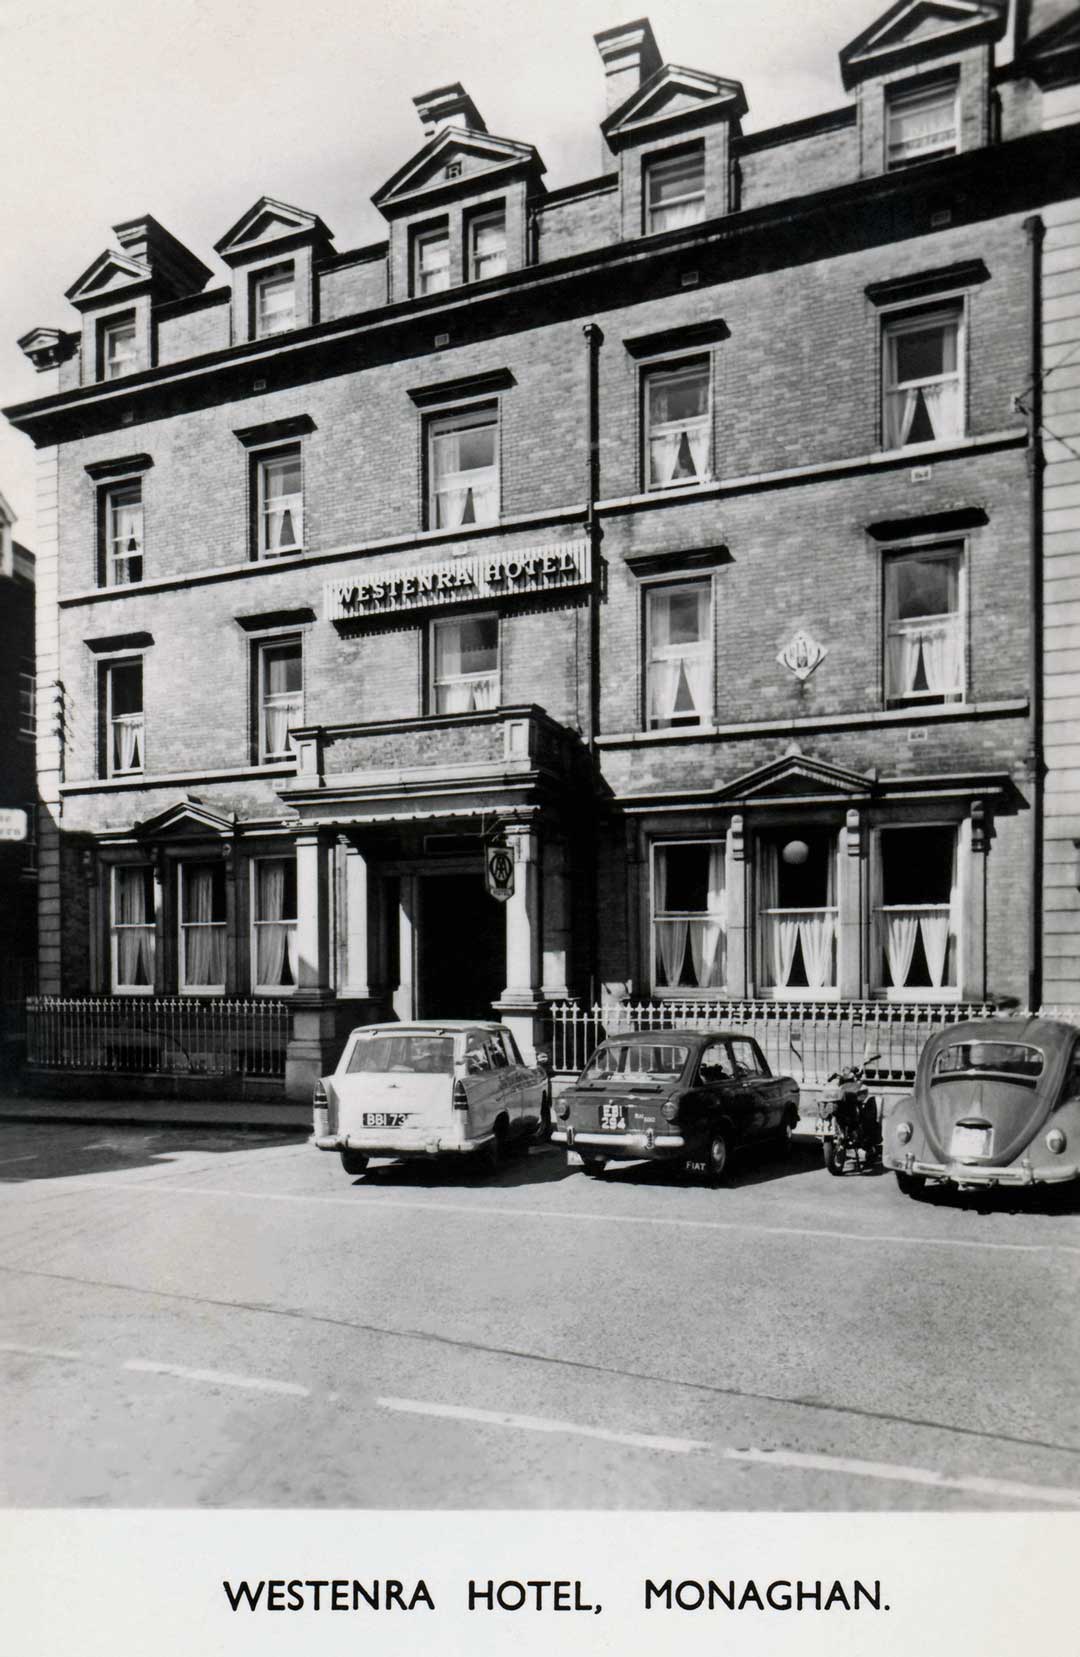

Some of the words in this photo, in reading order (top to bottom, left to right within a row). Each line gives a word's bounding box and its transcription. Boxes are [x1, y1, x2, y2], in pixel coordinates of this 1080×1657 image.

[337, 568, 474, 603] WESTENRA
[485, 553, 576, 582] HOTEL
[685, 1160, 706, 1171] FIAT
